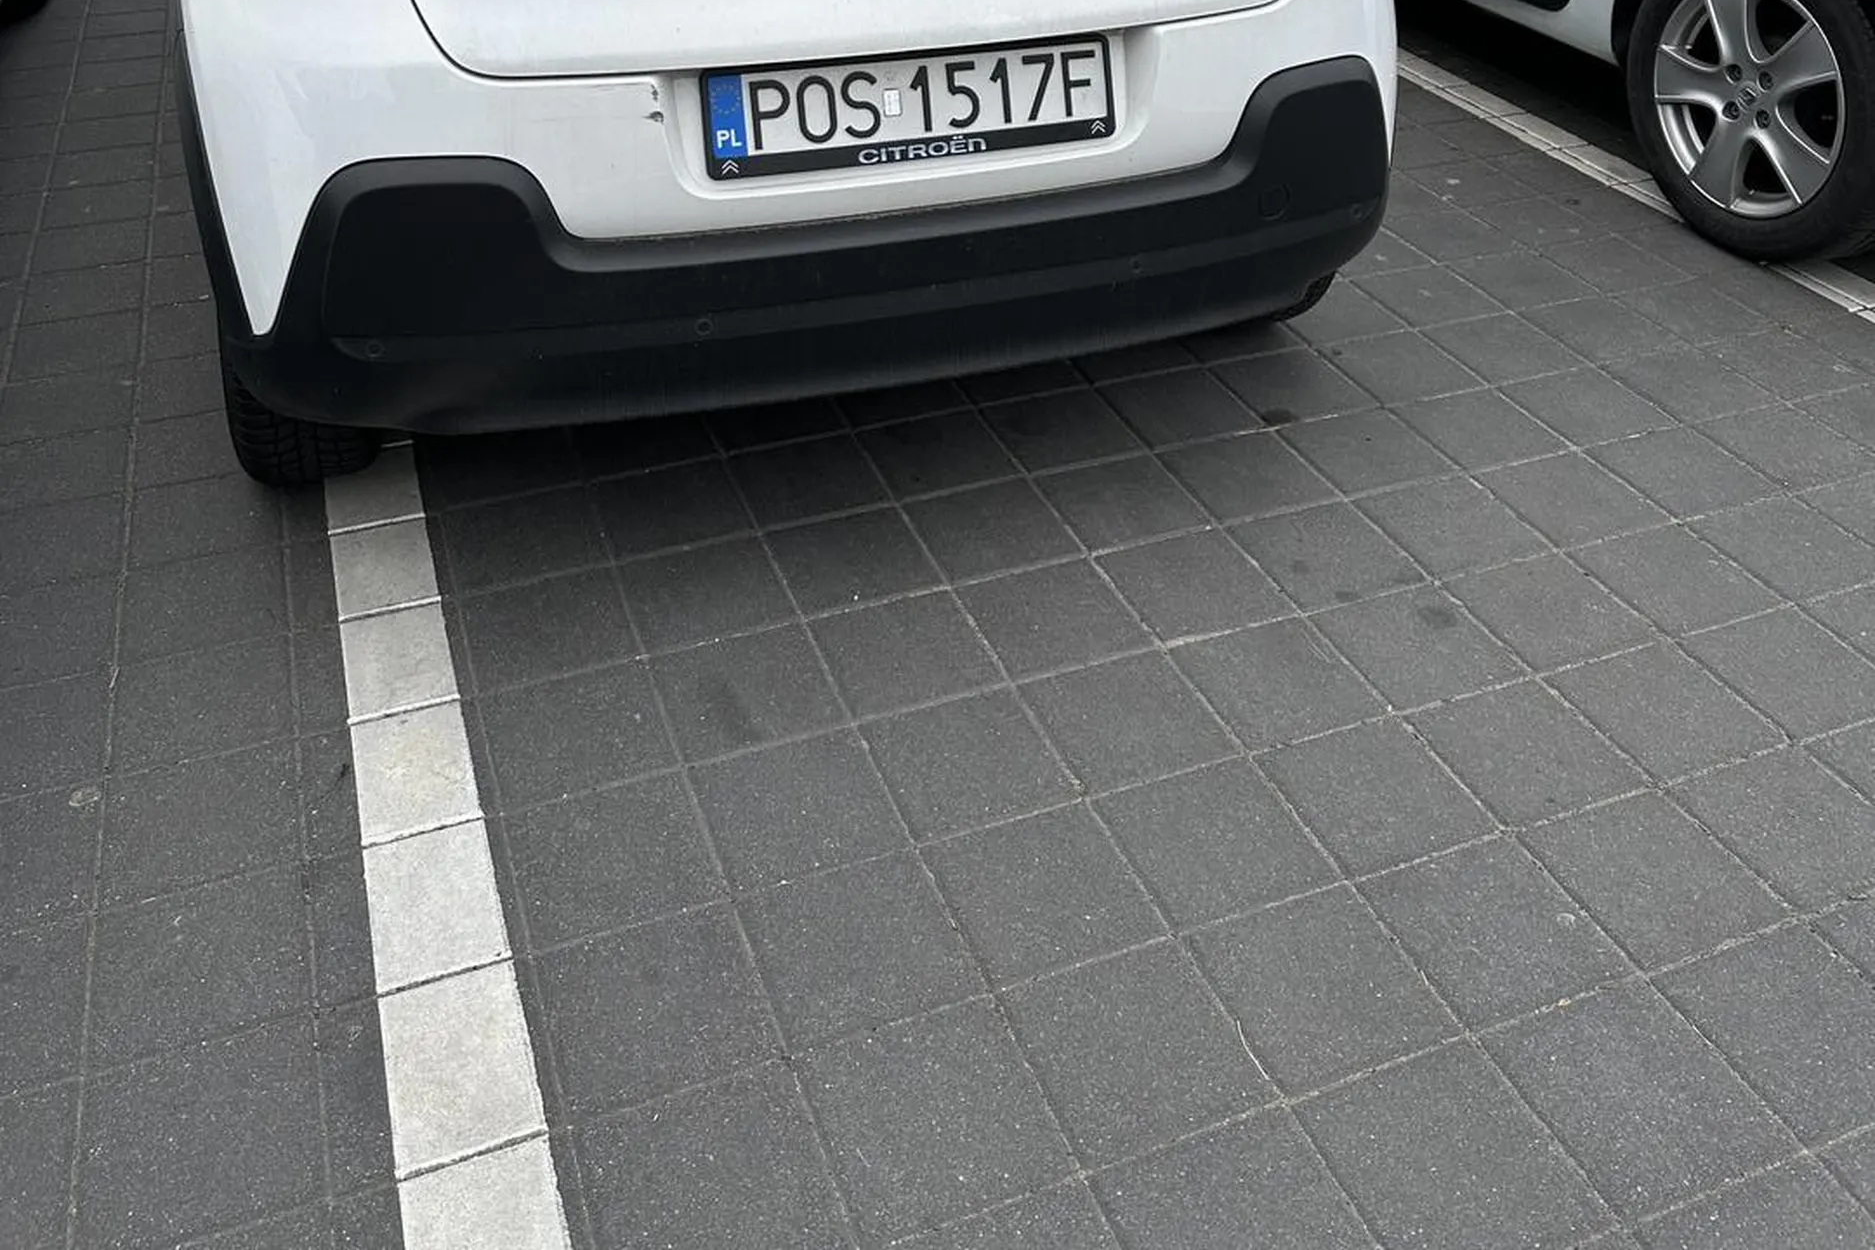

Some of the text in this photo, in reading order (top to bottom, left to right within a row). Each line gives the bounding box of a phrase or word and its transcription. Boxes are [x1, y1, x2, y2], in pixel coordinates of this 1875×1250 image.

[748, 49, 1096, 151] POS 1517F
[716, 128, 743, 149] PL
